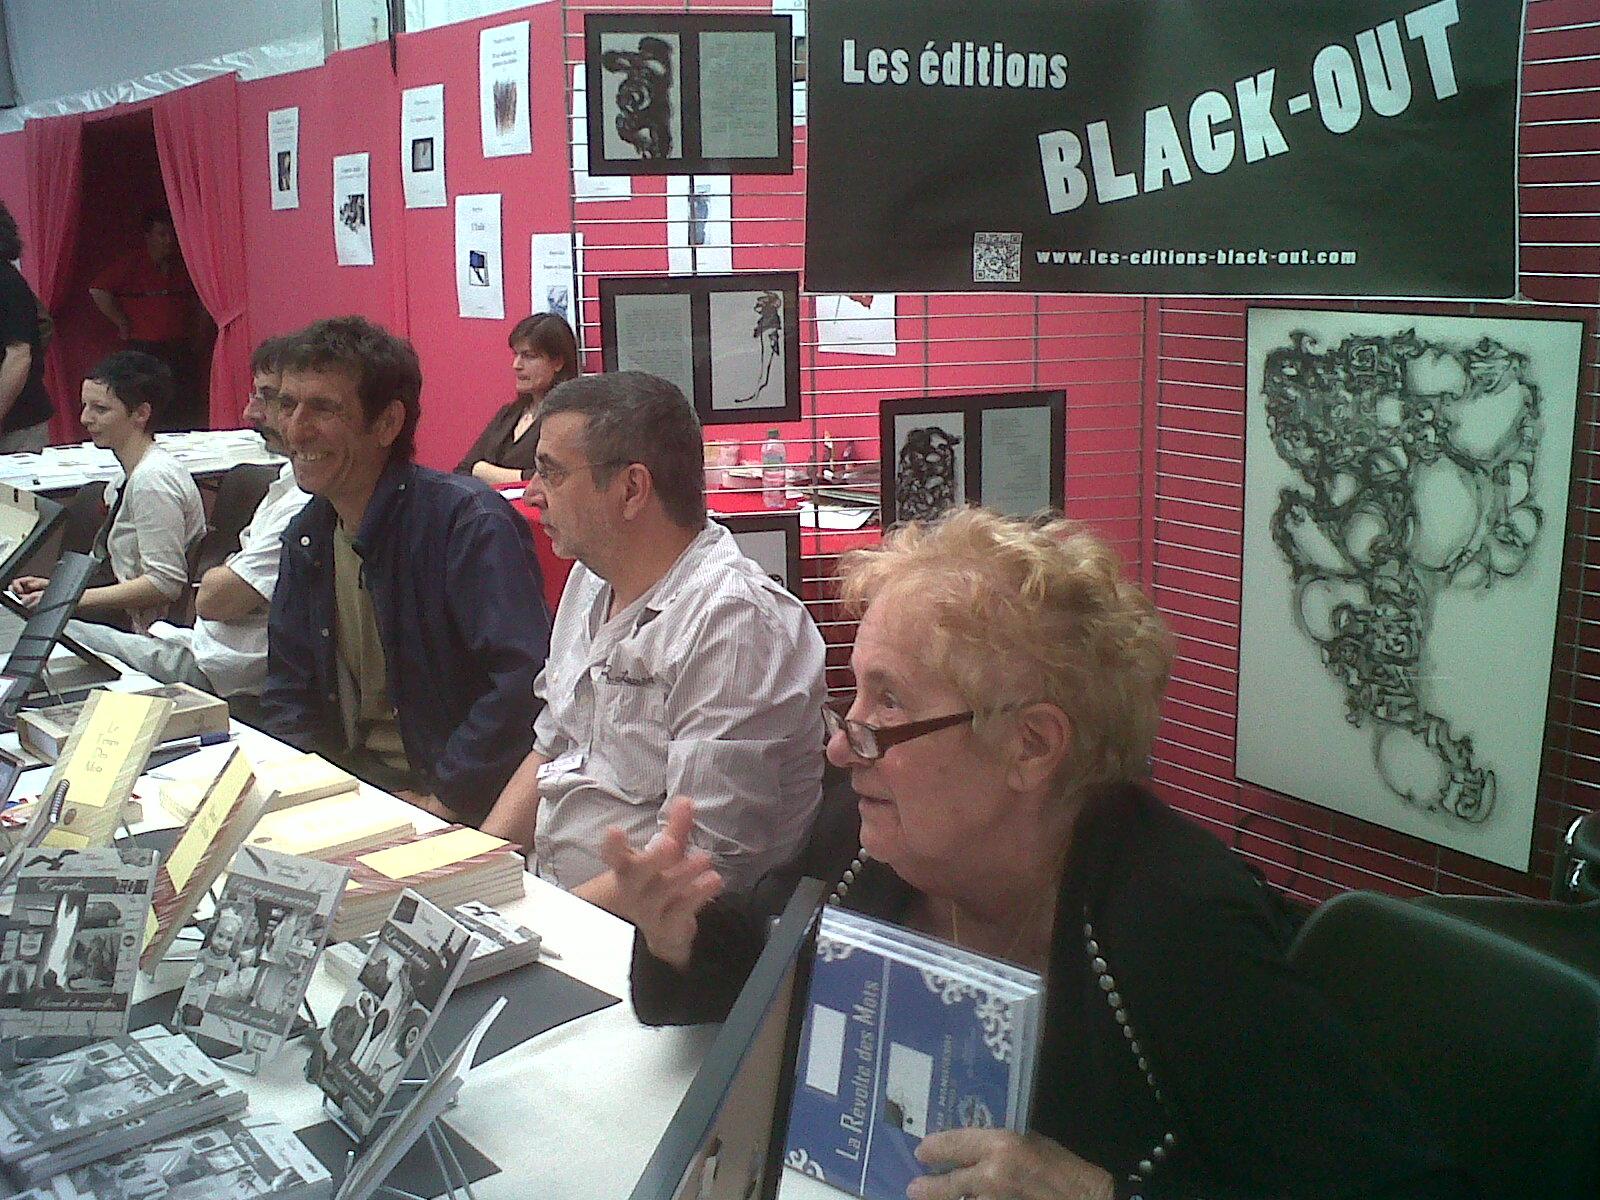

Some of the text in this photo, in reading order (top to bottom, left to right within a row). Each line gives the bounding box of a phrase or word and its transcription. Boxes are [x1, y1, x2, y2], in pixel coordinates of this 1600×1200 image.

[843, 39, 1068, 89] Les éditions
[1038, 0, 1460, 214] BLACK-OUT
[1036, 249, 1357, 265] www.les-editions-black-out.com
[835, 1137, 862, 1161] La
[854, 1030, 874, 1062] des
